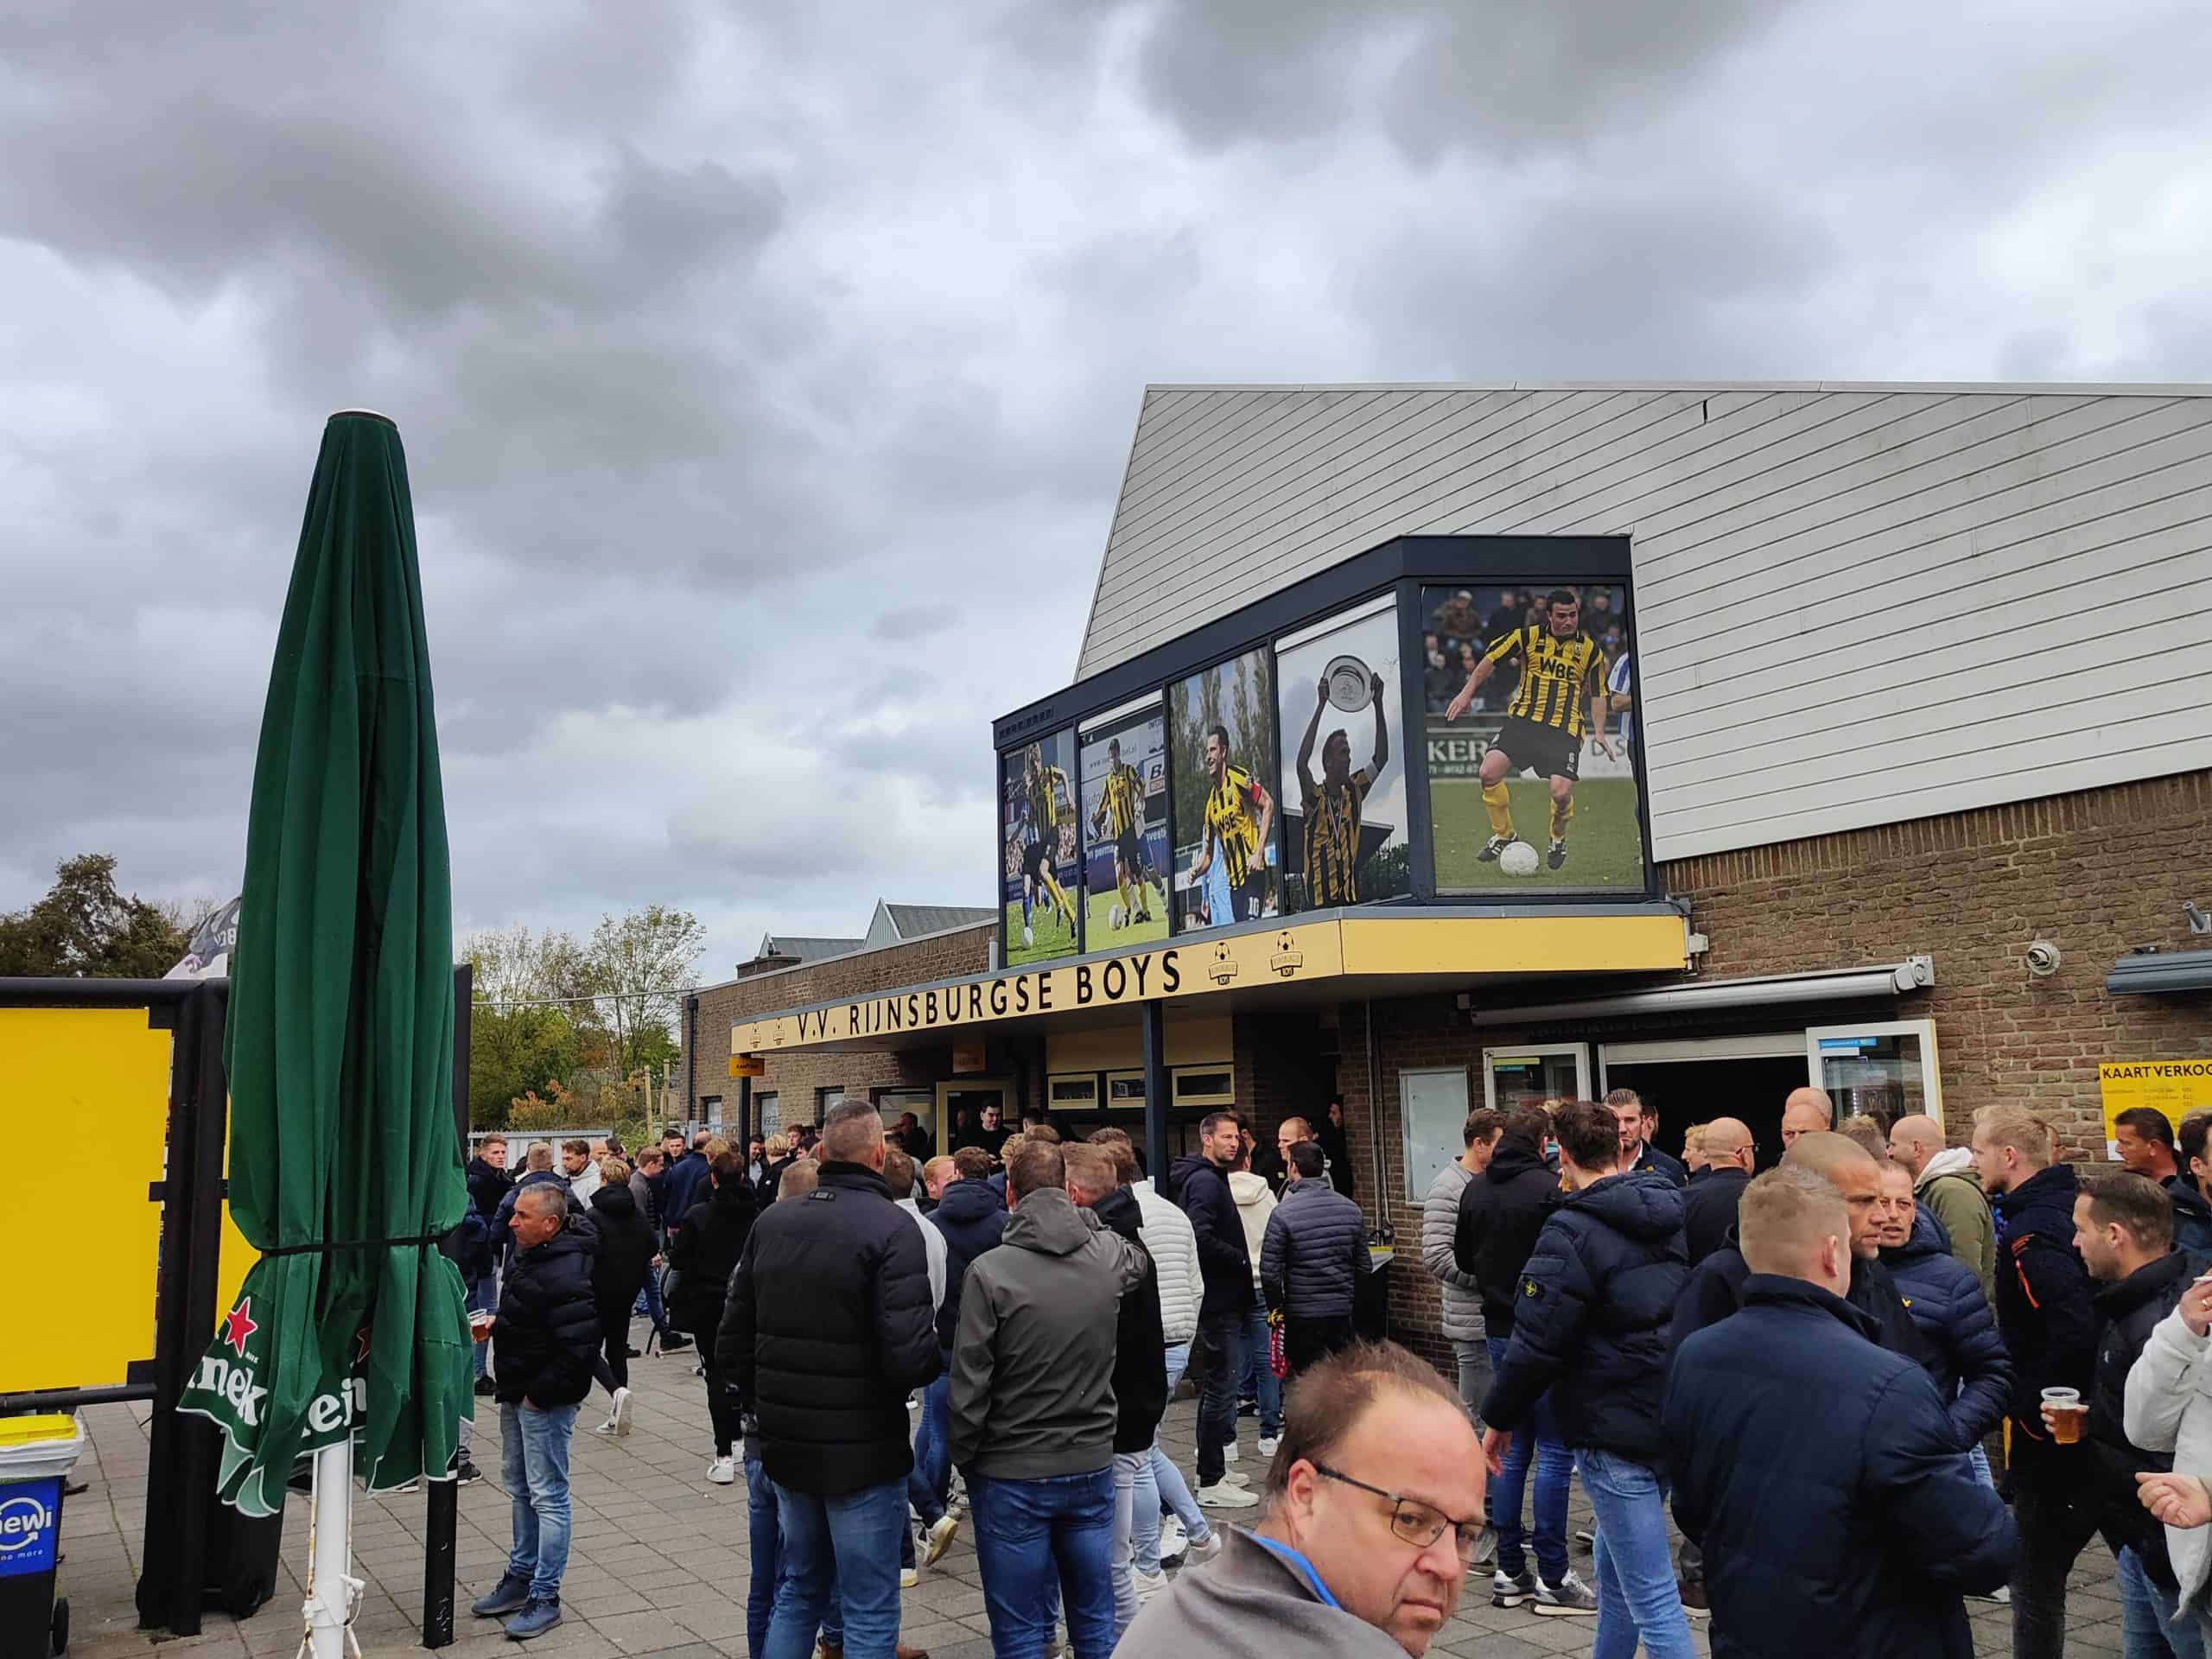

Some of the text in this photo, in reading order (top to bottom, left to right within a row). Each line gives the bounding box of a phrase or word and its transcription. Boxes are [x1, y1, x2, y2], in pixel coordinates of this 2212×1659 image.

[1539, 658, 1575, 678] WBE
[798, 950, 1180, 1042] V.V. RIJNSBURGSE BOYS
